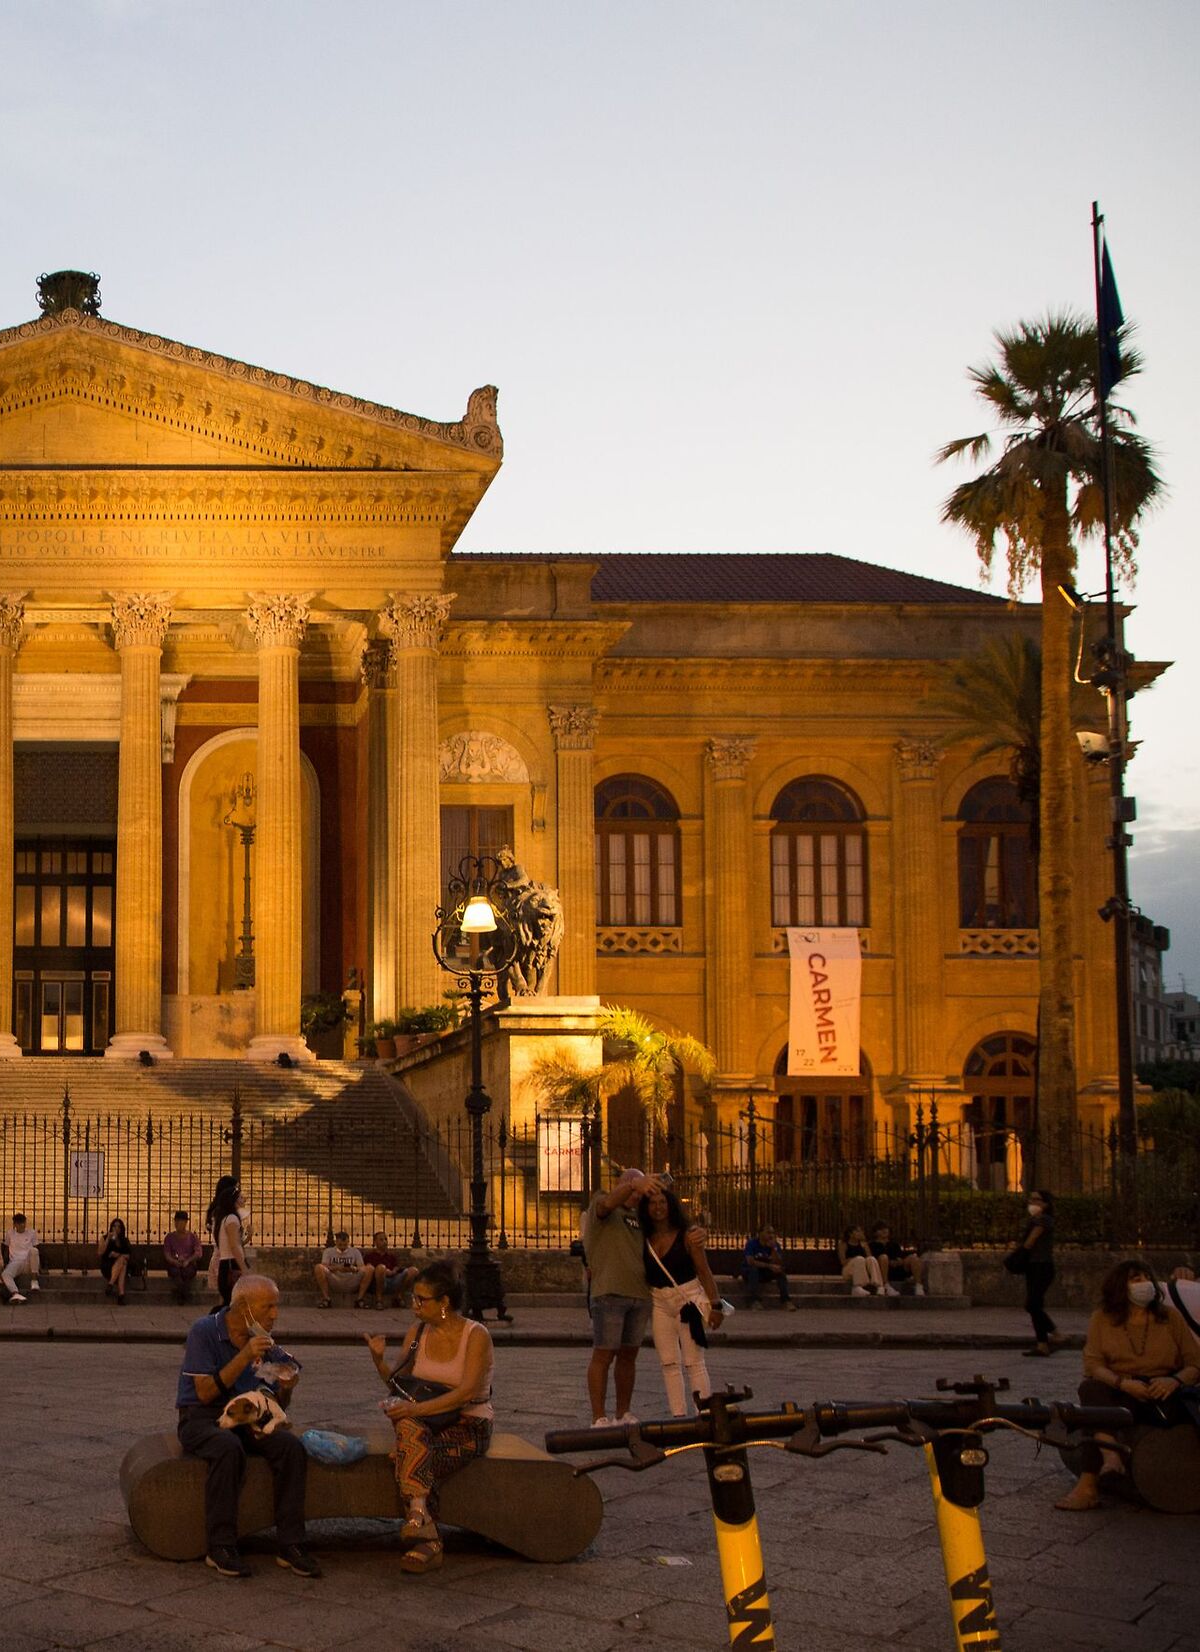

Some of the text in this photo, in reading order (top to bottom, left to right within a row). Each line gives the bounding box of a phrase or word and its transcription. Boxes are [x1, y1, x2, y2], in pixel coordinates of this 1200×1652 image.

[16, 530, 86, 543] POPOLI
[247, 530, 268, 543] LA
[281, 530, 328, 544] VITA
[39, 545, 69, 556] OVE
[82, 545, 117, 556] NON
[808, 953, 837, 1064] CARMEN
[803, 1058, 815, 1066] 22
